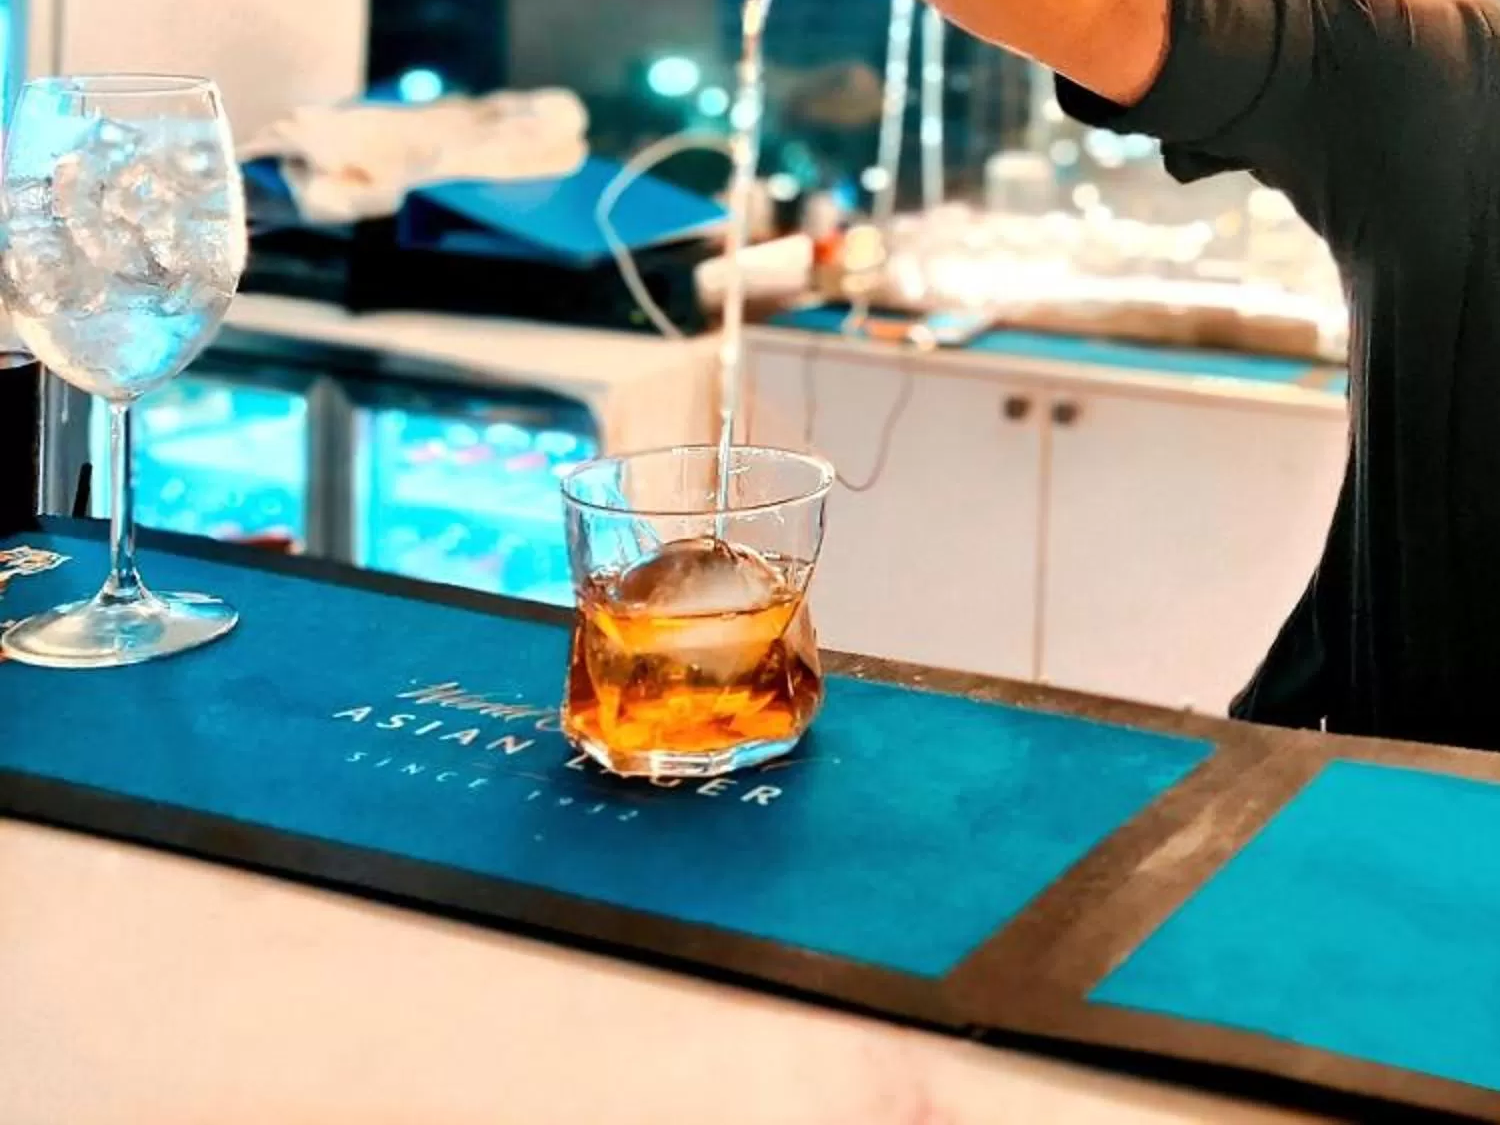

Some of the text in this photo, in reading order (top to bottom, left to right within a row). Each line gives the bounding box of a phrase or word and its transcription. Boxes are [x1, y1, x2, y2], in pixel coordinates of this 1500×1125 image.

[332, 706, 782, 805] ASIAN LER
[345, 751, 489, 789] SINCE
